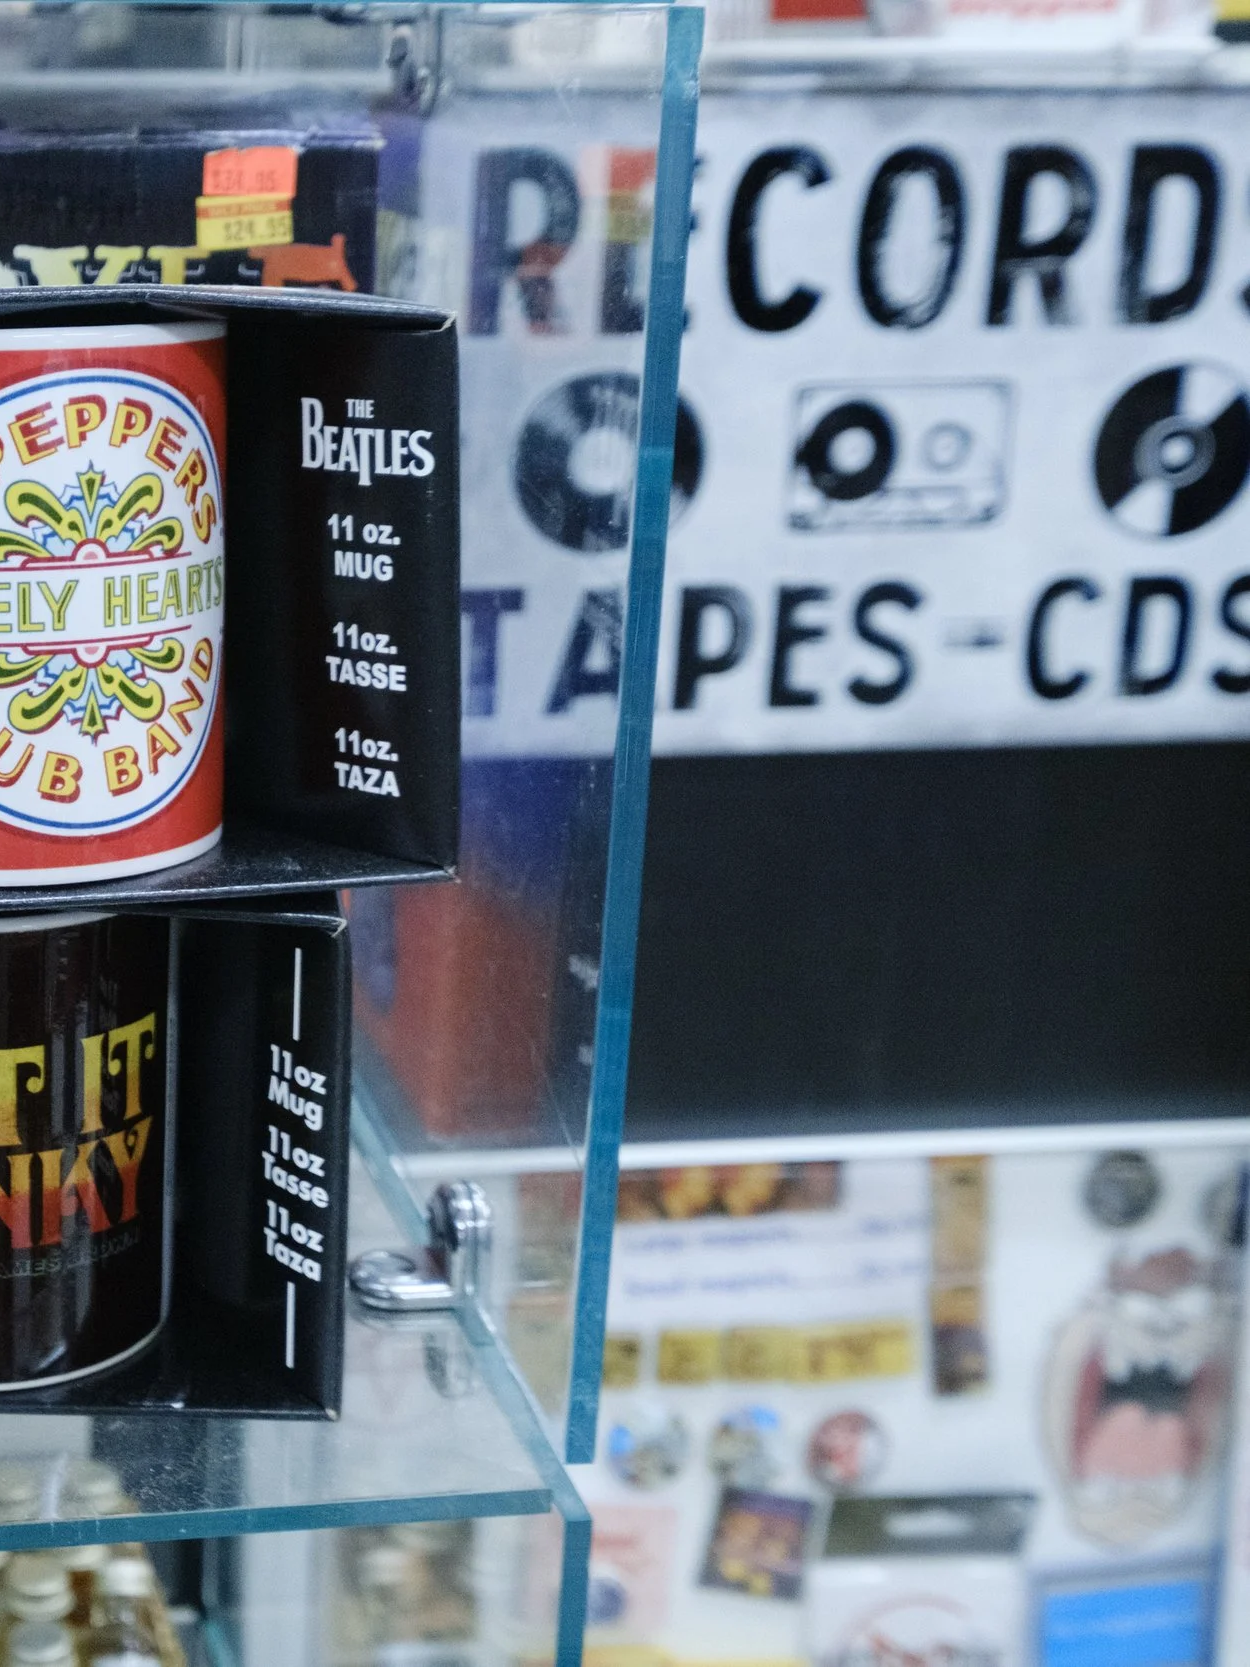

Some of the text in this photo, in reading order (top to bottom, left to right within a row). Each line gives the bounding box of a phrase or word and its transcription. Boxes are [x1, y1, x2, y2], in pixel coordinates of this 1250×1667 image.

[470, 143, 1250, 335] RECORD
[345, 398, 375, 419] THE
[301, 397, 435, 486] BEATLES
[327, 513, 401, 545] 11 oz.
[103, 556, 223, 628] HEARTS
[334, 550, 394, 581] MUG
[325, 655, 407, 691] TASSE
[460, 580, 926, 717] TAPES
[103, 637, 214, 796] BAND
[334, 761, 401, 797] TAZA
[79, 1012, 157, 1134] IT
[270, 1044, 327, 1095] 11oz
[268, 1075, 323, 1131] Mug
[269, 1125, 325, 1178] 11oz
[262, 1151, 329, 1208] Tasse
[267, 1199, 324, 1253] 11oz
[263, 1227, 322, 1282] Taza
